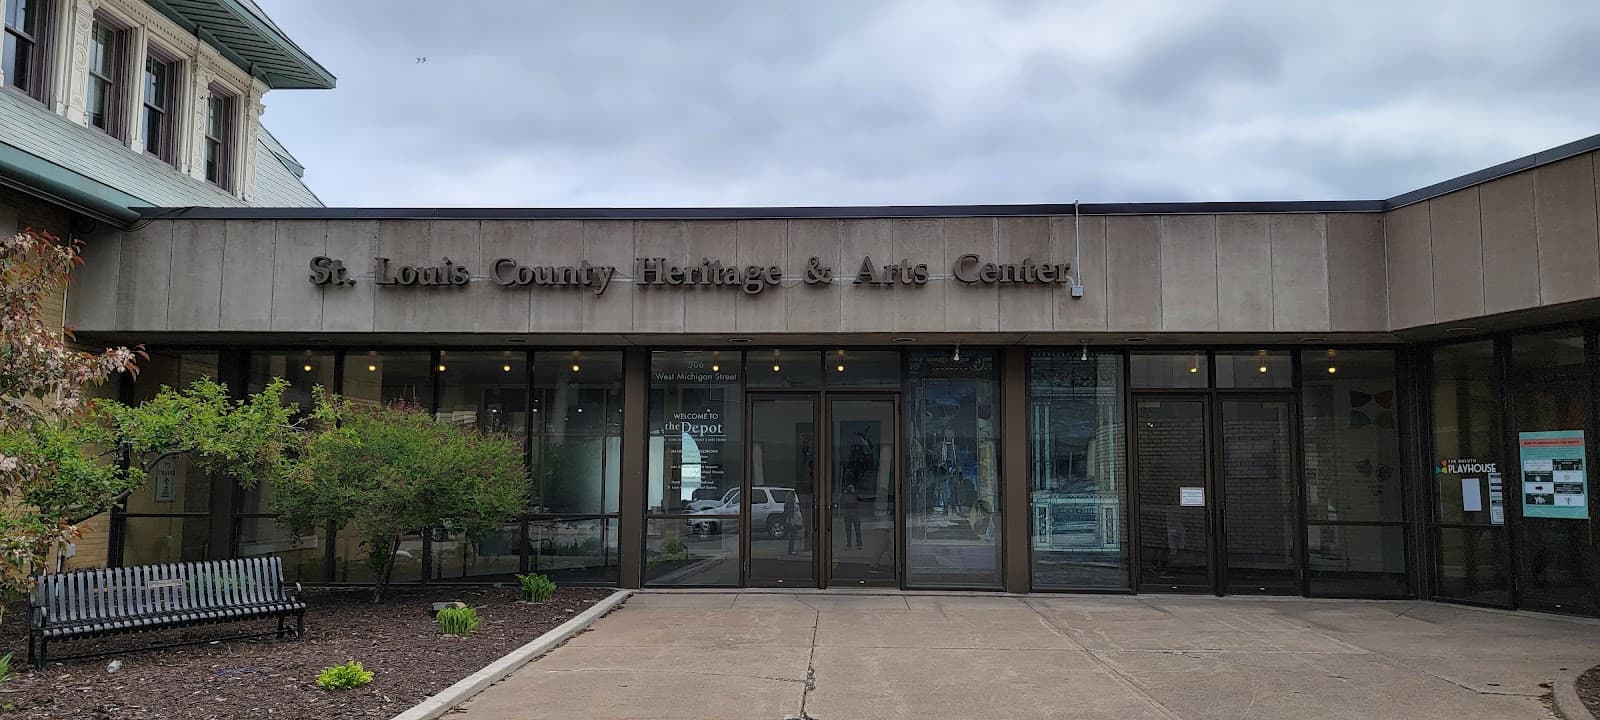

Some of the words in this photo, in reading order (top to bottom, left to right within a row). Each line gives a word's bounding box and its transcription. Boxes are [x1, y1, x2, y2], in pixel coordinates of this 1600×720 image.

[309, 256, 356, 286] St.
[374, 257, 470, 286] Louis
[489, 257, 615, 295] County
[636, 257, 782, 294] Heritage
[803, 256, 832, 285] &
[853, 255, 929, 285] Arts
[953, 253, 1071, 284] Center
[688, 361, 704, 369] 506
[656, 373, 675, 381] West
[677, 373, 712, 382] Michigan
[715, 373, 737, 381] Street
[681, 421, 722, 436] Depot
[1448, 463, 1497, 474] PLAYHOUSE
